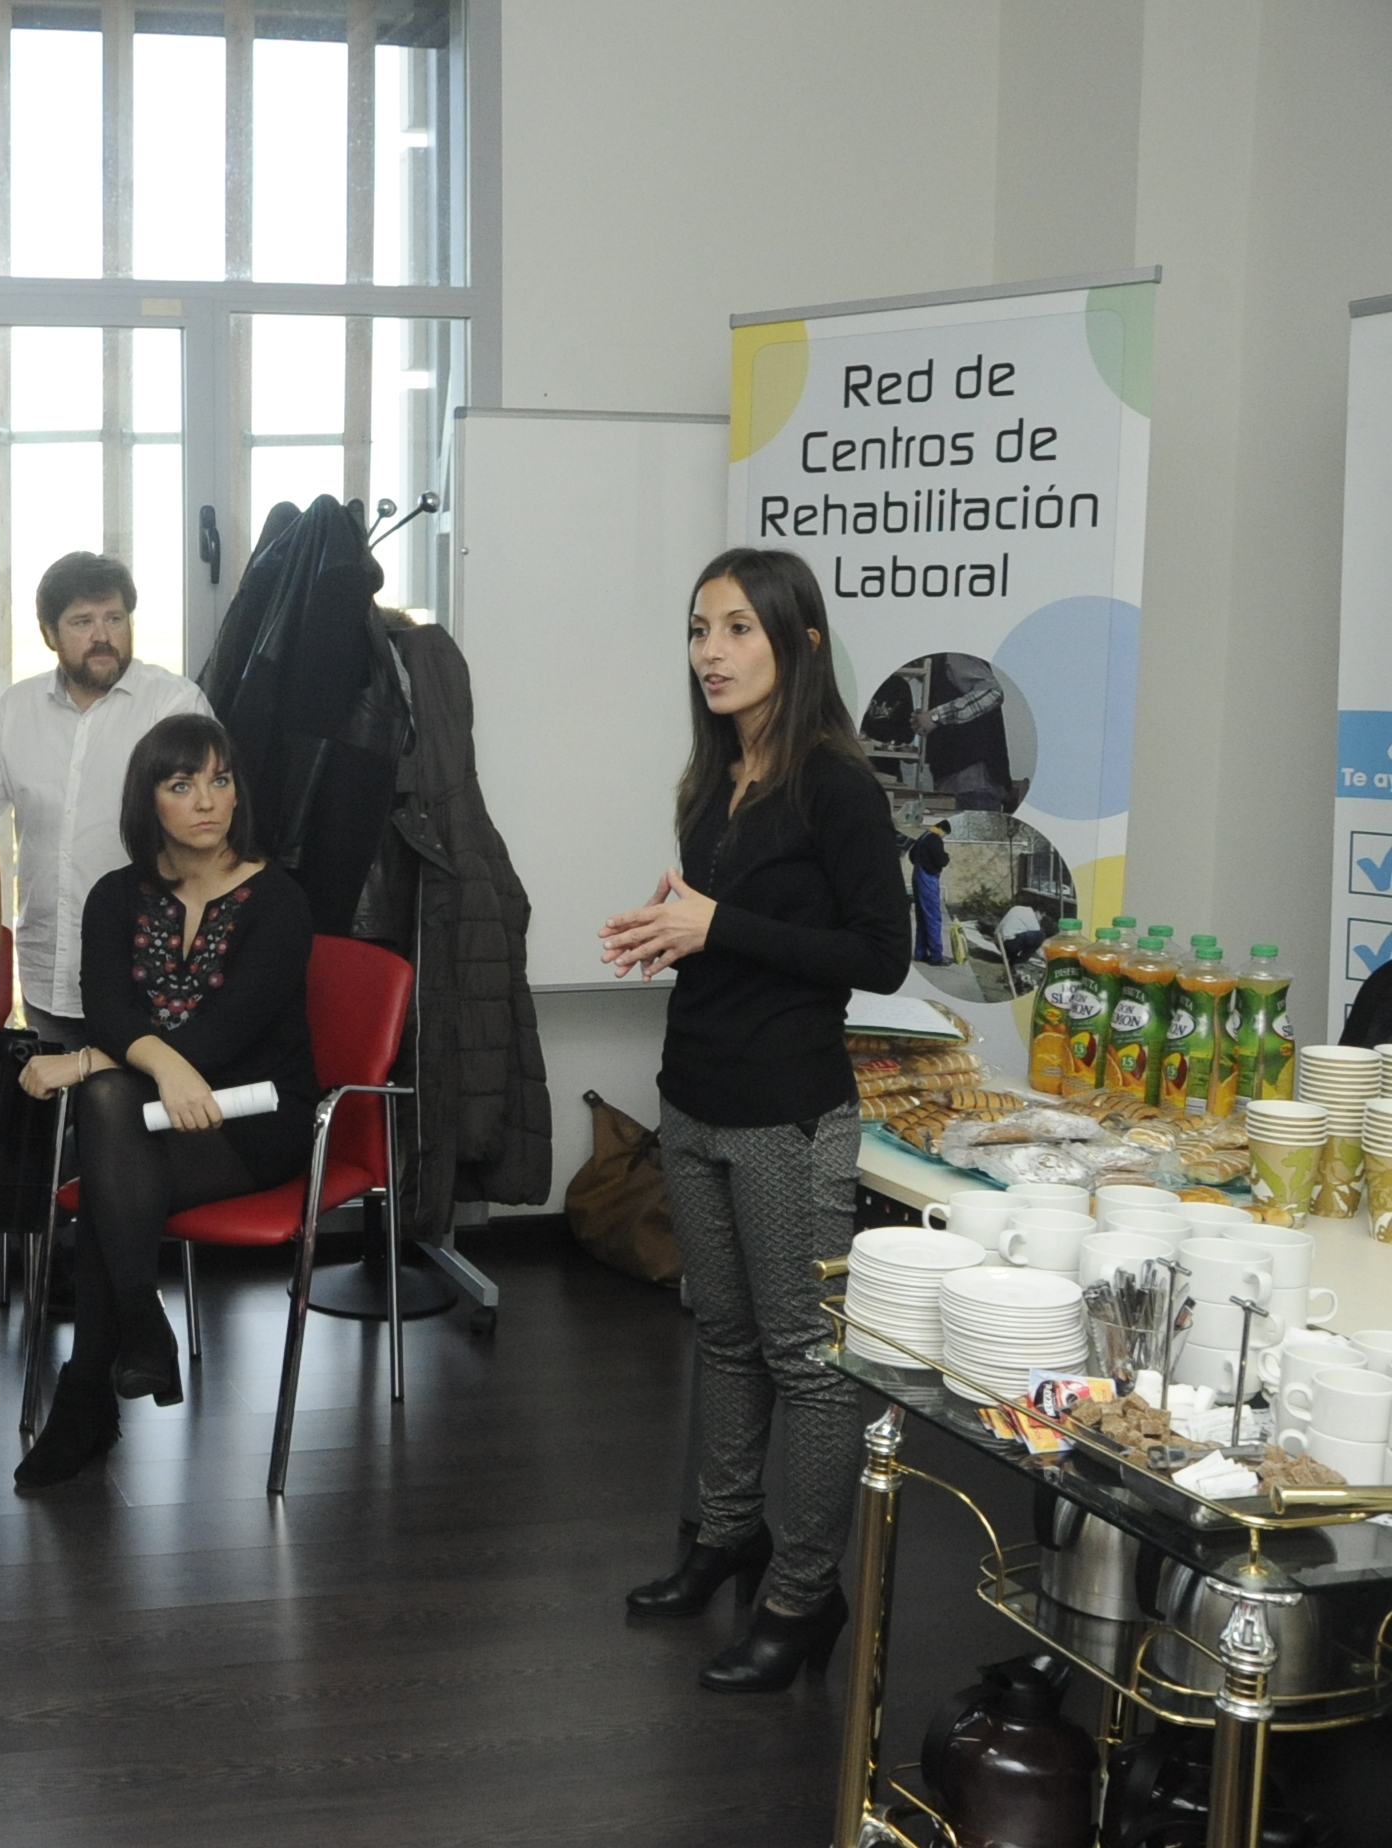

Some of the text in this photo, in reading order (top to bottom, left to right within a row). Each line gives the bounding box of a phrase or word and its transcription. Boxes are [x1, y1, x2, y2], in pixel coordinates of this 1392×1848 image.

[843, 354, 1016, 409] Red de
[802, 417, 1058, 474] Centros de
[760, 484, 1099, 538] Rehabilitación
[834, 552, 1009, 598] Laboral
[1341, 767, 1368, 787] Te
